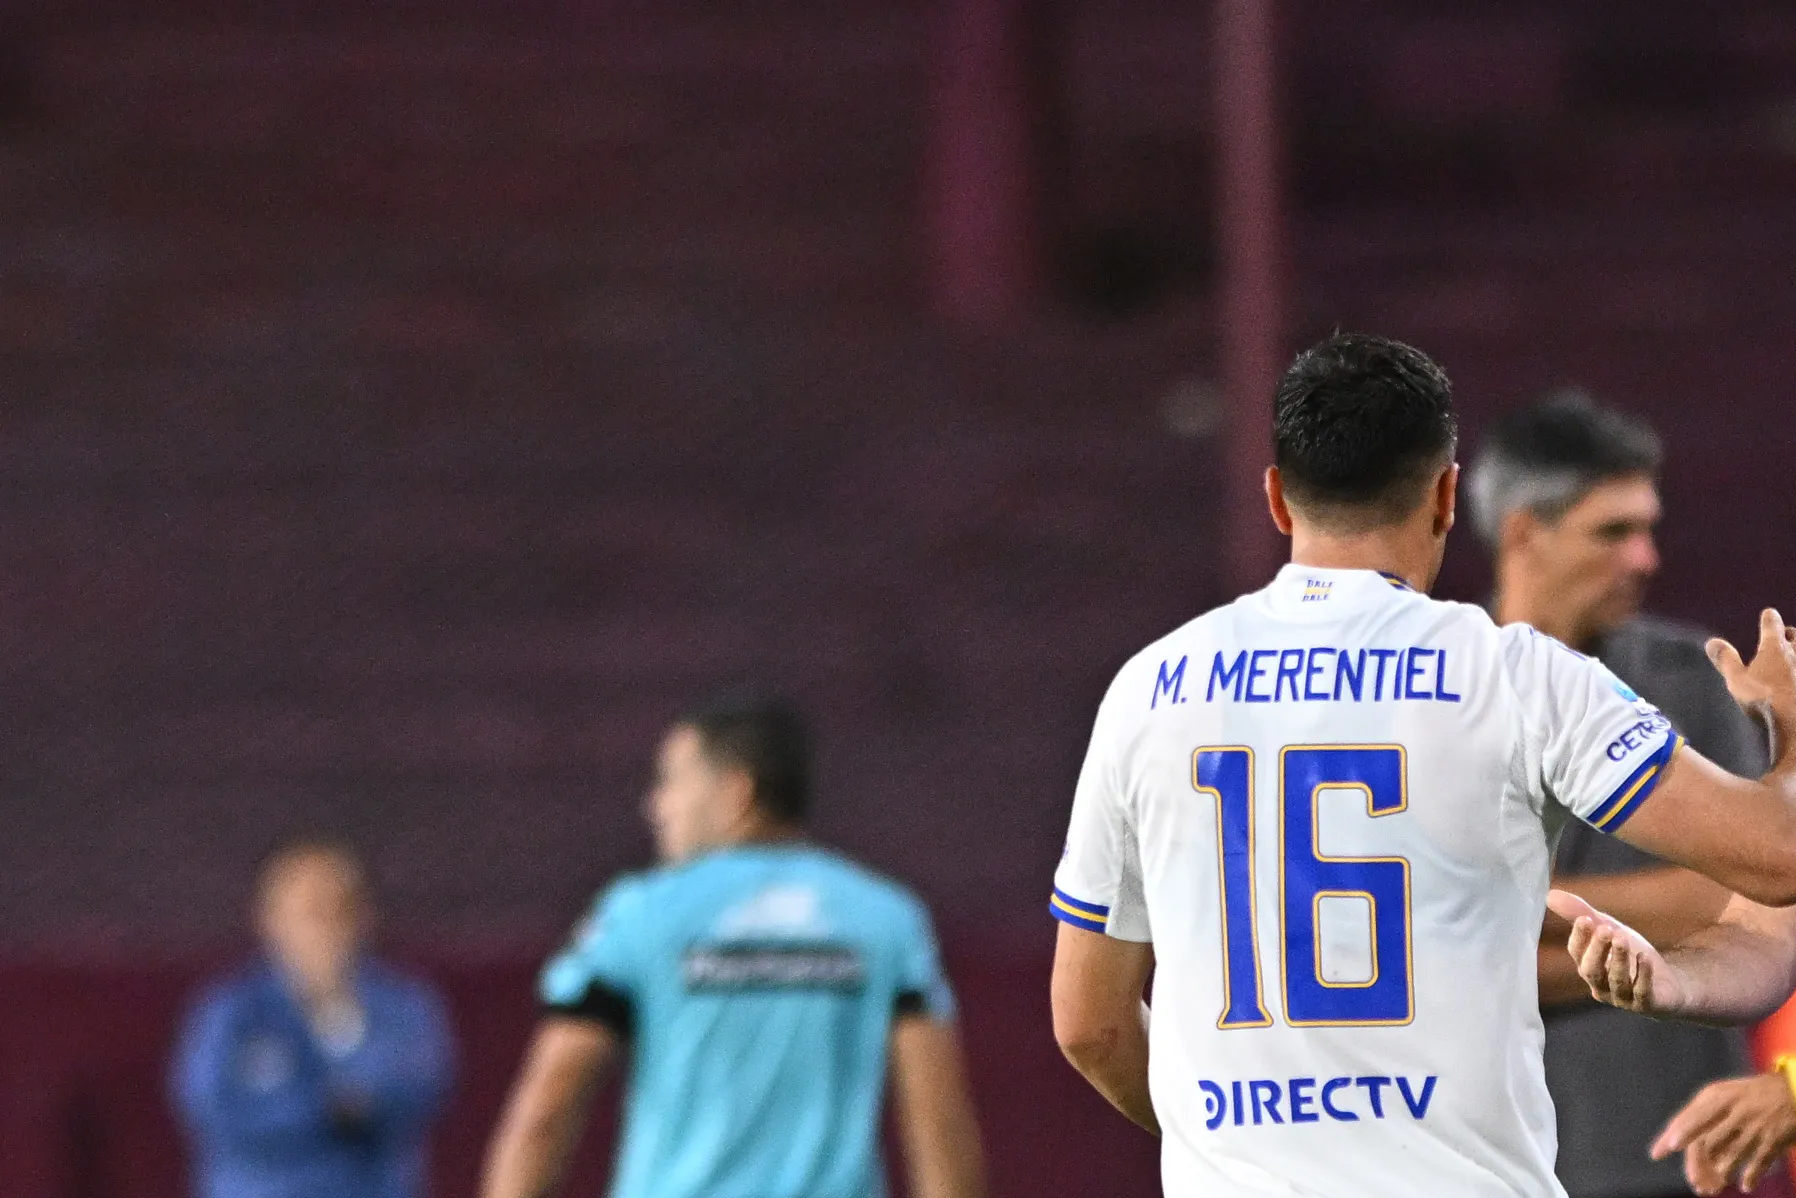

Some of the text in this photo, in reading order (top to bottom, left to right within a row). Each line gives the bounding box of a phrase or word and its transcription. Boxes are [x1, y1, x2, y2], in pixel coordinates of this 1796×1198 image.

[1151, 647, 1461, 709] M. MERENTIEL
[1193, 743, 1414, 1030] 16
[1198, 1075, 1438, 1131] DIRECTV
